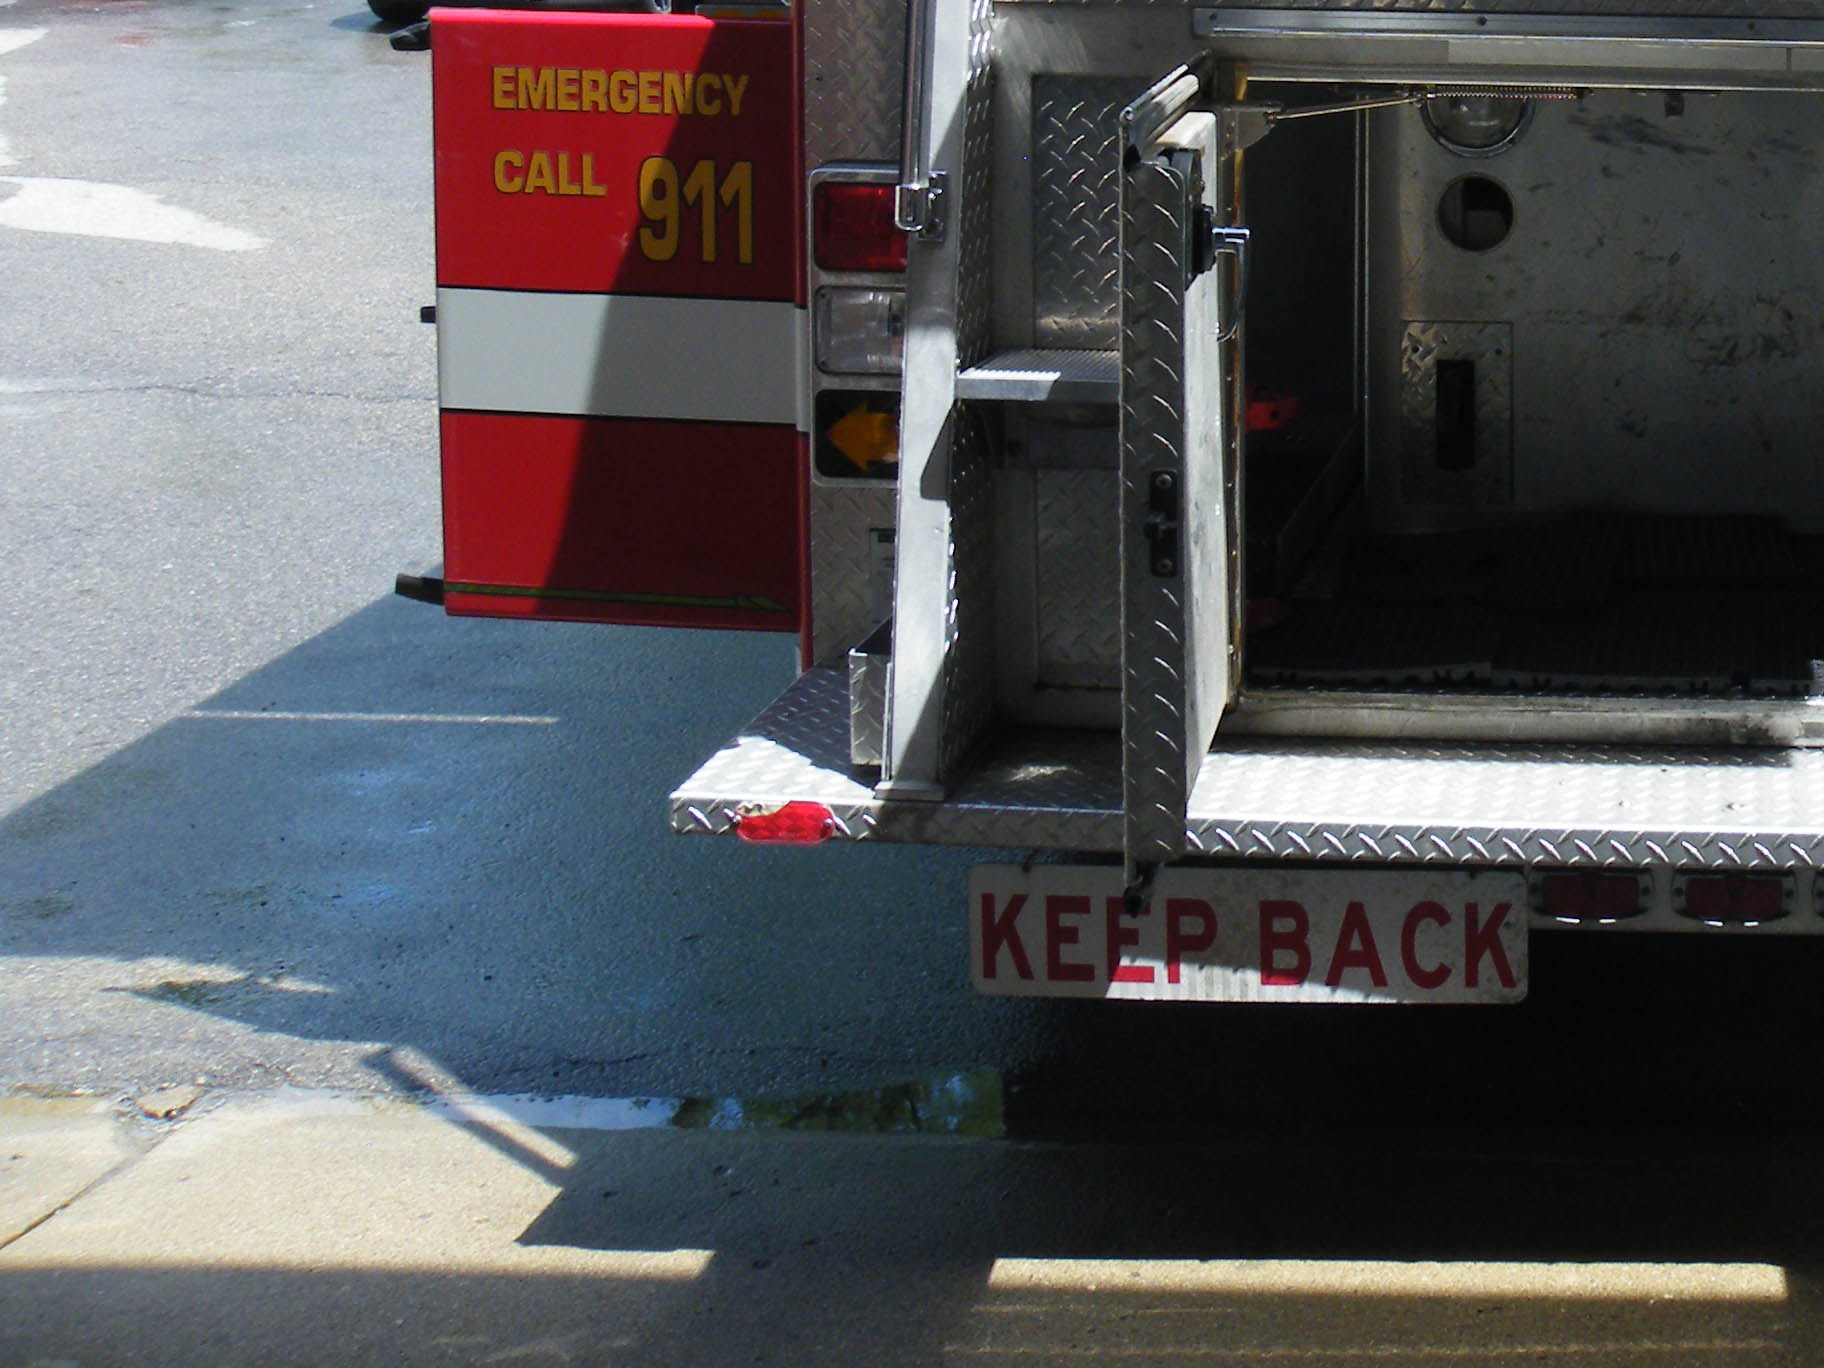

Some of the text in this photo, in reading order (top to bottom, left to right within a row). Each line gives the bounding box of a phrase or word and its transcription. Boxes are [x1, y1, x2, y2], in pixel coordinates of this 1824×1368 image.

[492, 66, 748, 116] EMERGENCY
[494, 150, 753, 265] CALL 911
[980, 892, 1516, 989] KEEP BACK
